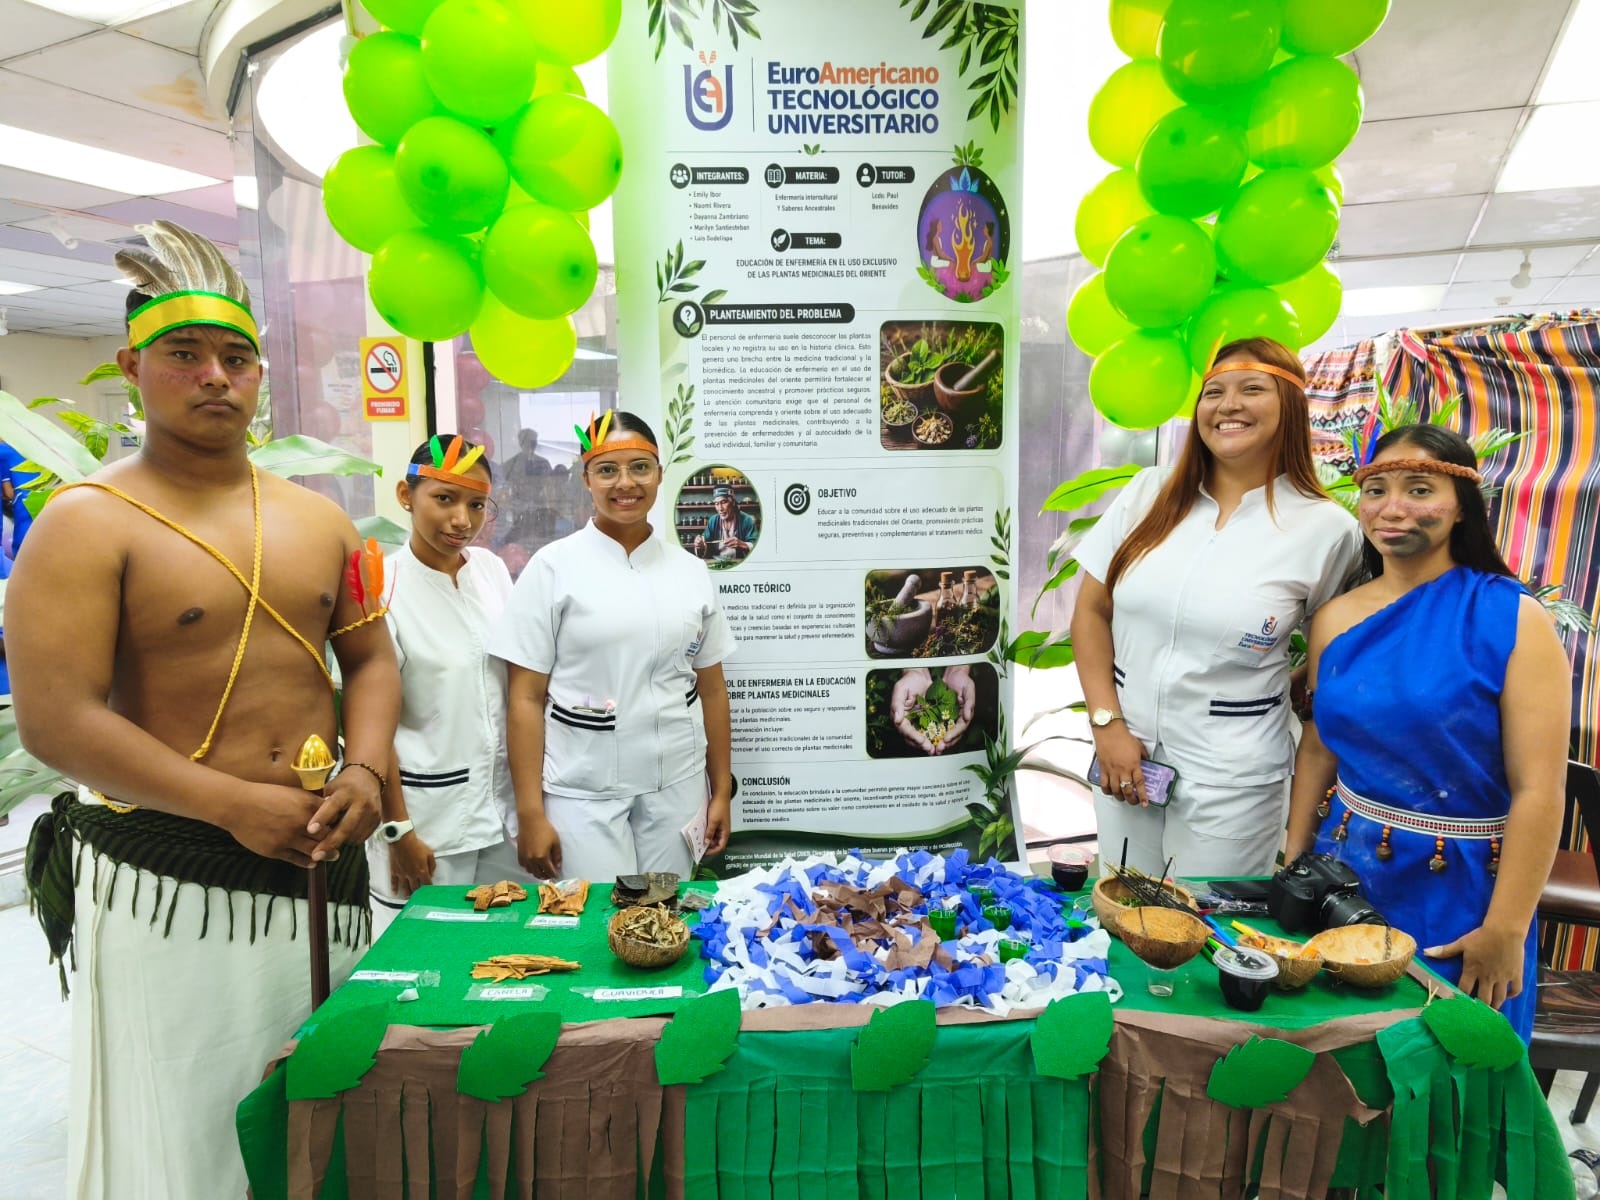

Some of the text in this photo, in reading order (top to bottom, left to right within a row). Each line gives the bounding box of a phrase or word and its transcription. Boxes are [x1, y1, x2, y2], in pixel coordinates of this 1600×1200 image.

[768, 61, 940, 84] EuroAmericano
[767, 86, 939, 110] TECNOLÓGICO
[768, 113, 940, 135] UNIVERSITARIO
[696, 172, 745, 180] INTEGRANTES:
[881, 170, 906, 179] TUTOR:
[805, 237, 826, 245] TEMA:
[736, 259, 774, 267] EDUCACIÓN
[828, 258, 838, 266] EN
[839, 258, 846, 266] EL
[847, 258, 861, 266] USO
[862, 258, 898, 266] EXCLUSIVO
[801, 270, 844, 278] MEDICINALES
[845, 270, 858, 278] DEL
[710, 308, 842, 320] PLANTEAMIENTO DEL PROBLEMA
[817, 488, 857, 498] OBJETIVO
[719, 582, 791, 594] MARCO TEÓRICO
[737, 679, 747, 688] DE
[794, 678, 804, 686] EN
[806, 678, 815, 686] LA
[816, 677, 856, 685] EDUCACIÓN
[747, 691, 780, 699] PLANTAS
[781, 690, 830, 699] MEDICINALES
[741, 777, 790, 786] CONCLUSIÓN
